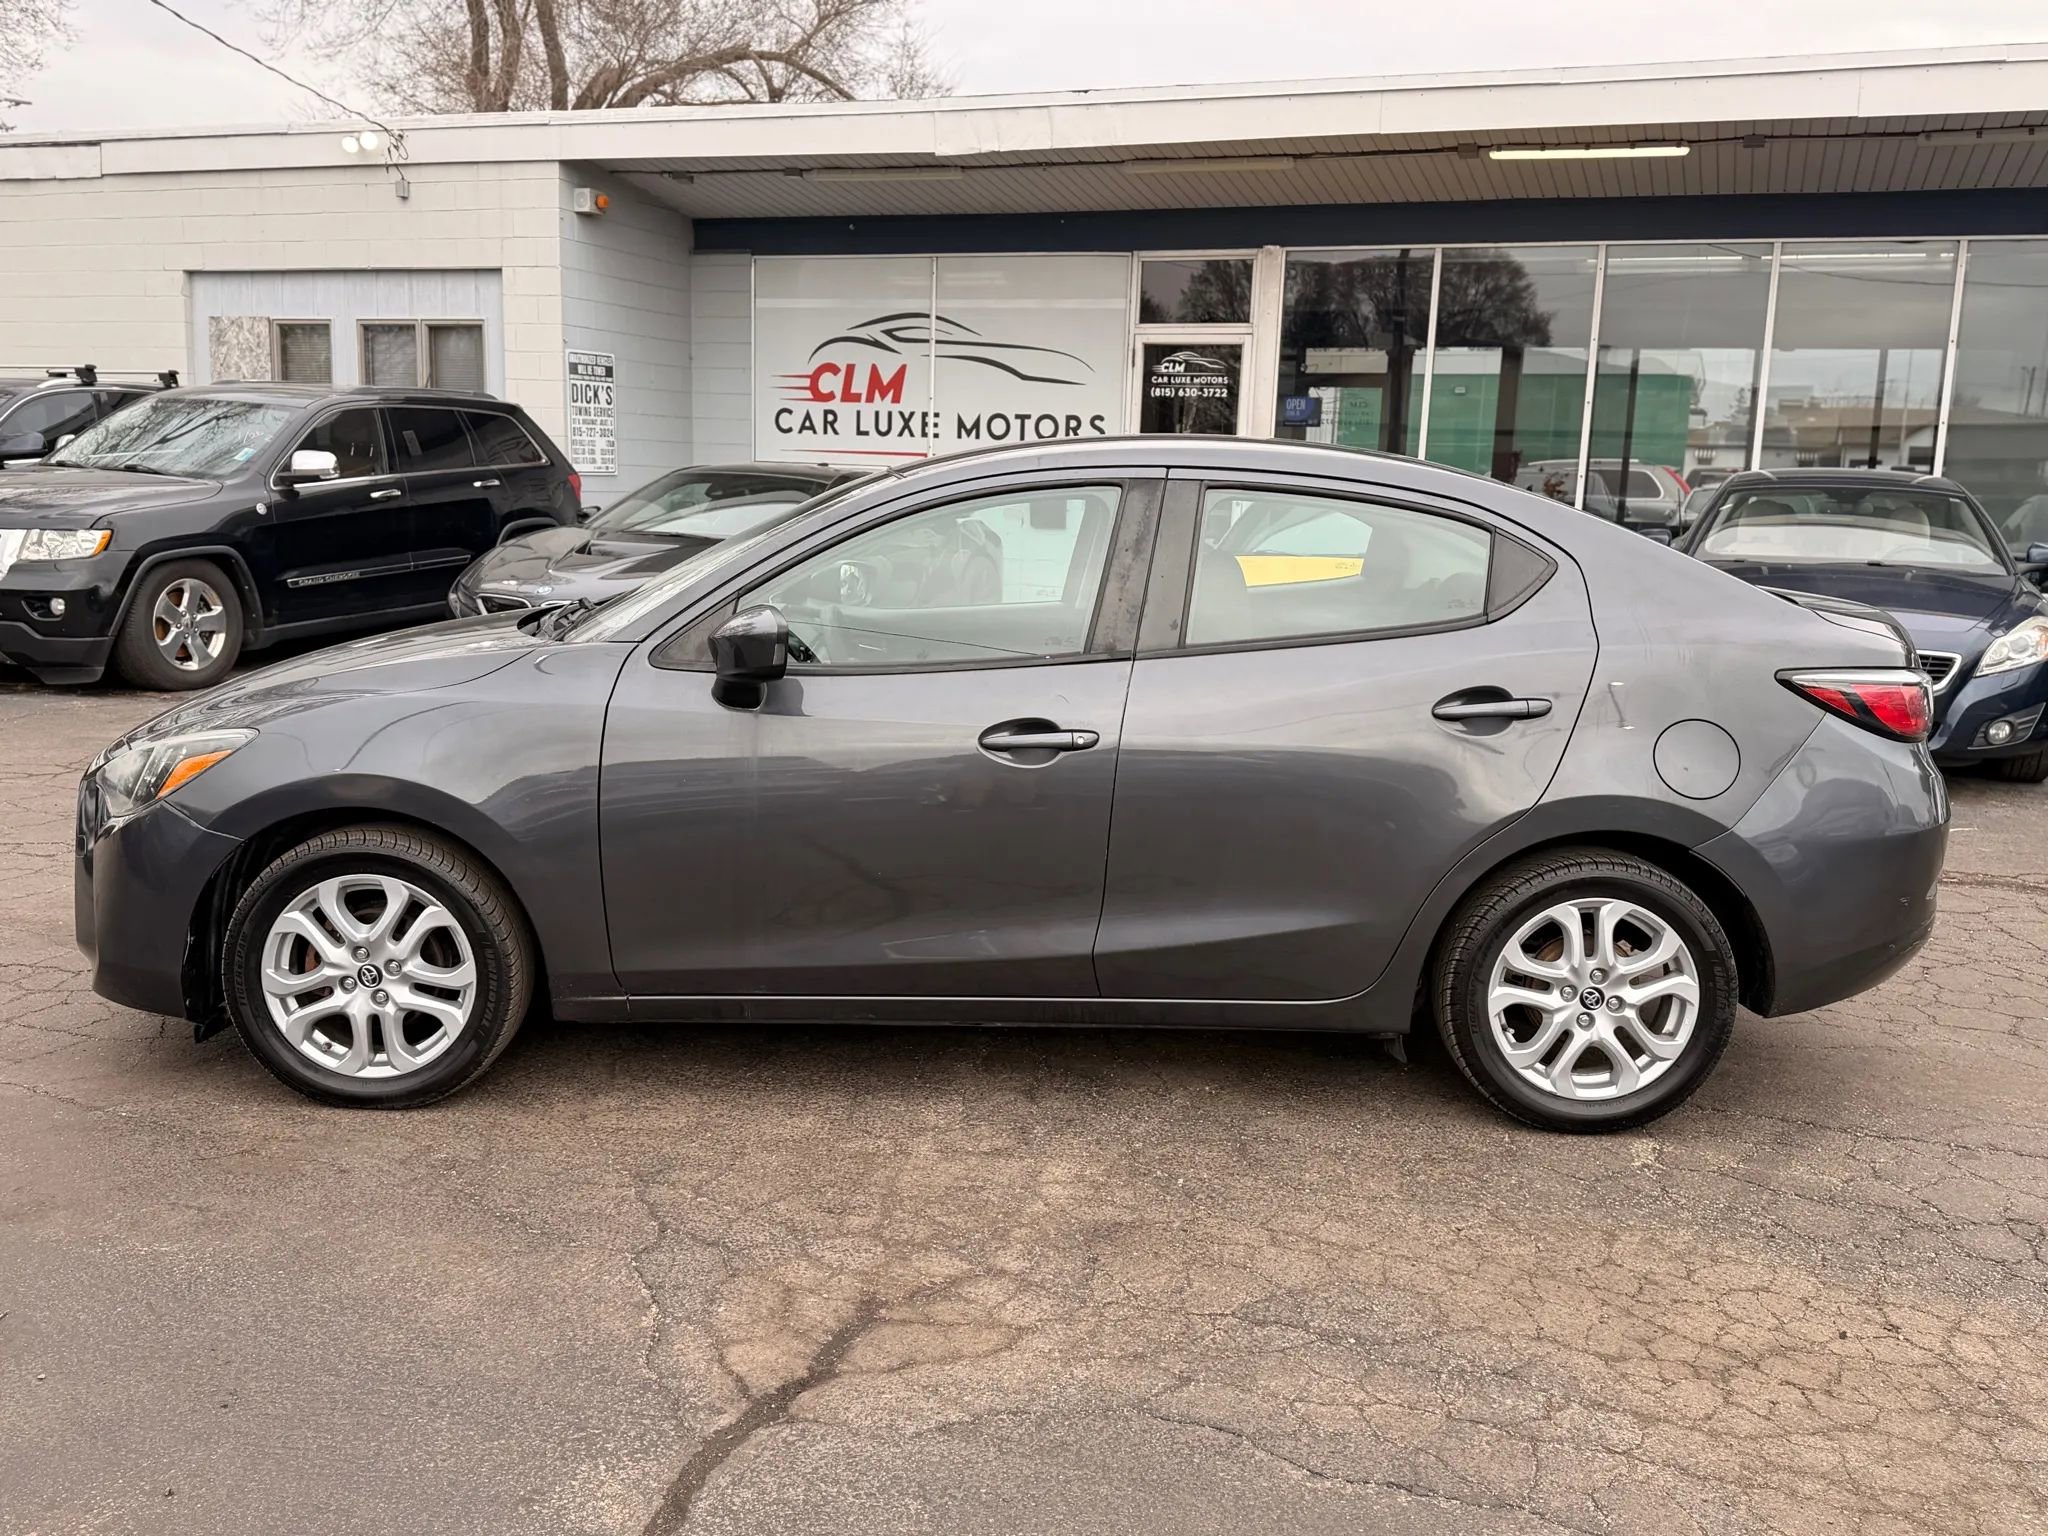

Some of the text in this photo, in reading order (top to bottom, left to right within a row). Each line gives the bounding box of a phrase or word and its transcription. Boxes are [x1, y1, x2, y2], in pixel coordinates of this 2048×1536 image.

[1161, 362, 1186, 373] CLM
[809, 362, 908, 404] CLM
[1151, 376, 1229, 384] CAR LUXE MOTORS
[571, 383, 613, 406] DICK'S
[1150, 386, 1228, 398] (815) 630-3722
[1286, 398, 1306, 410] OPEN
[571, 405, 615, 418] TOWING SERVICE
[774, 407, 1106, 442] CAR LUXE MOTORS
